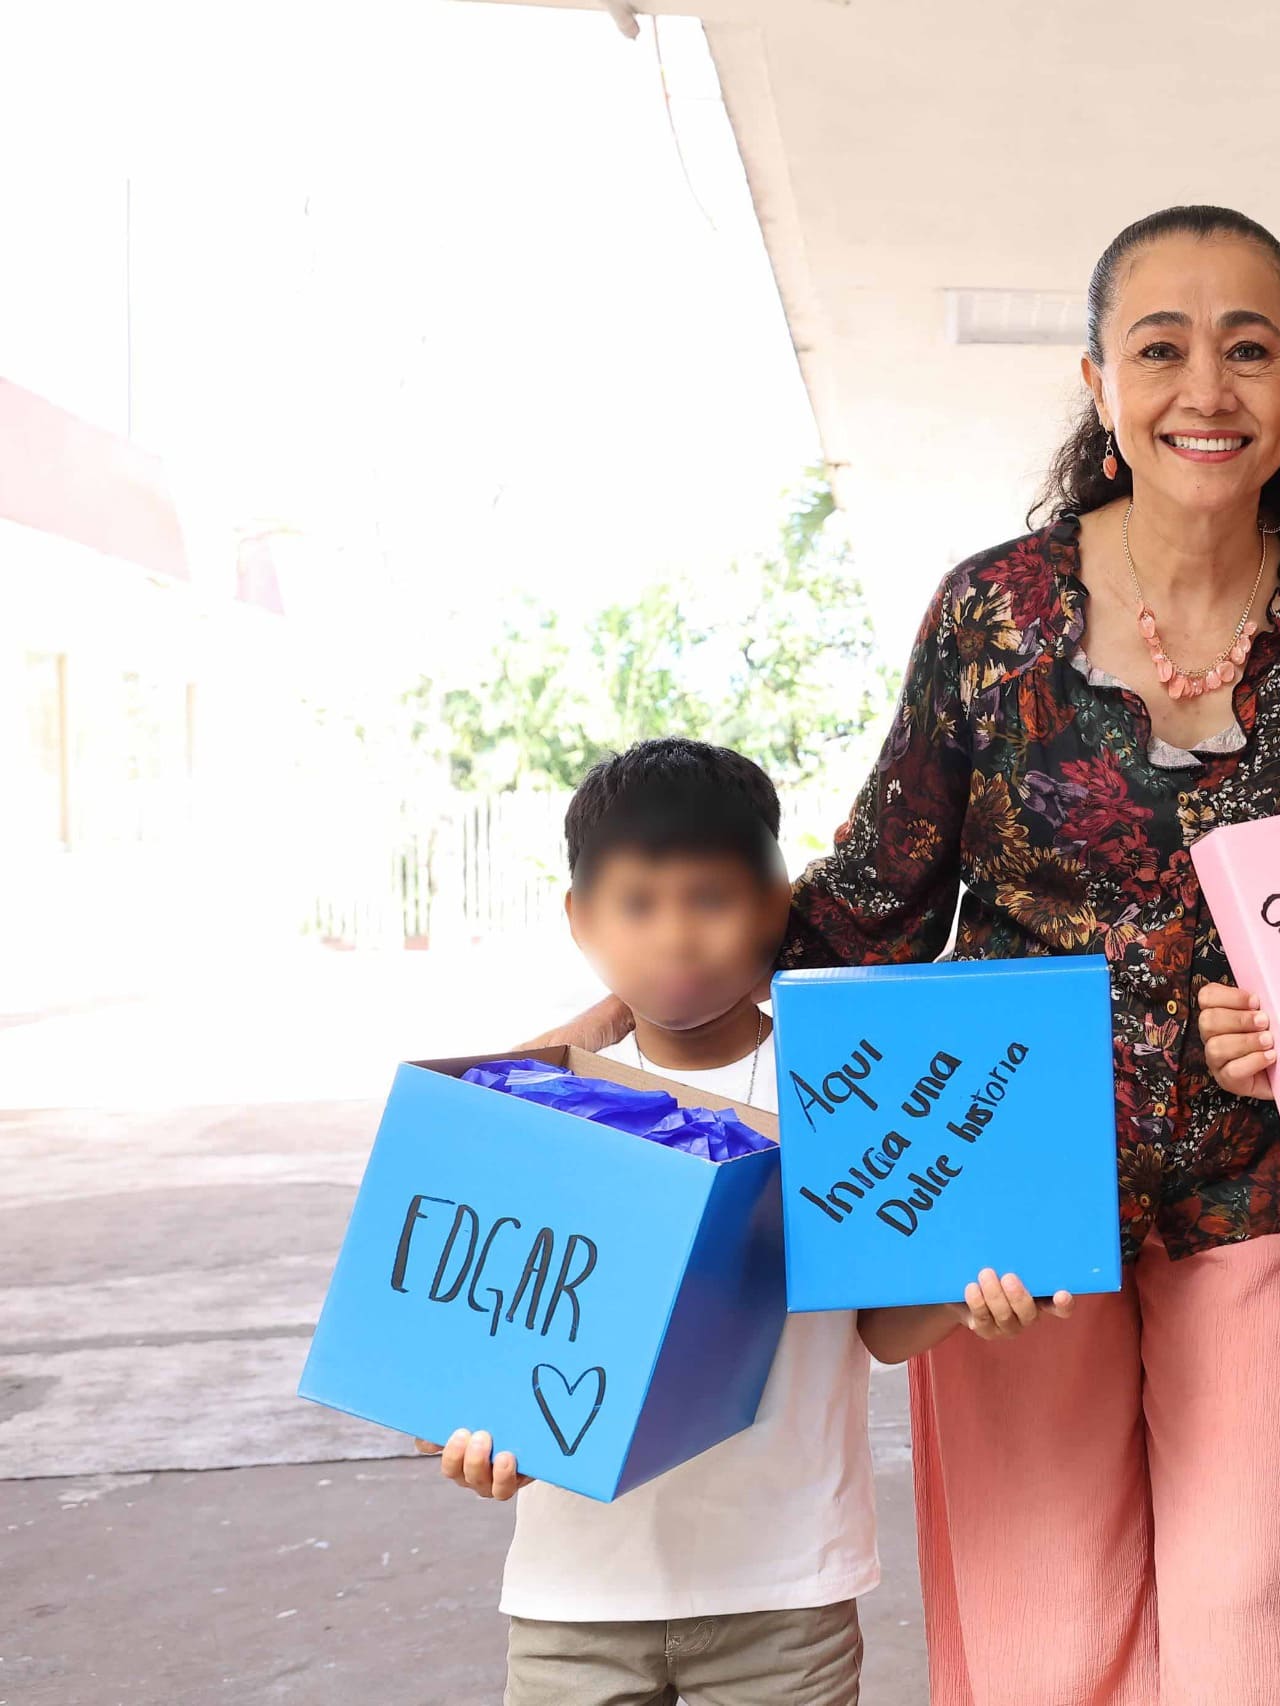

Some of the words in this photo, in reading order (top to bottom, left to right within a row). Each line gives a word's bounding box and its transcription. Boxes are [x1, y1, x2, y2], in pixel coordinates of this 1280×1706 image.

[788, 1038, 884, 1133] Aqui
[799, 1130, 912, 1224] Inicia
[900, 1050, 963, 1118] una
[875, 1154, 964, 1238] Dulce
[945, 1042, 1030, 1144] historia
[390, 1194, 598, 1343] EDGAR
